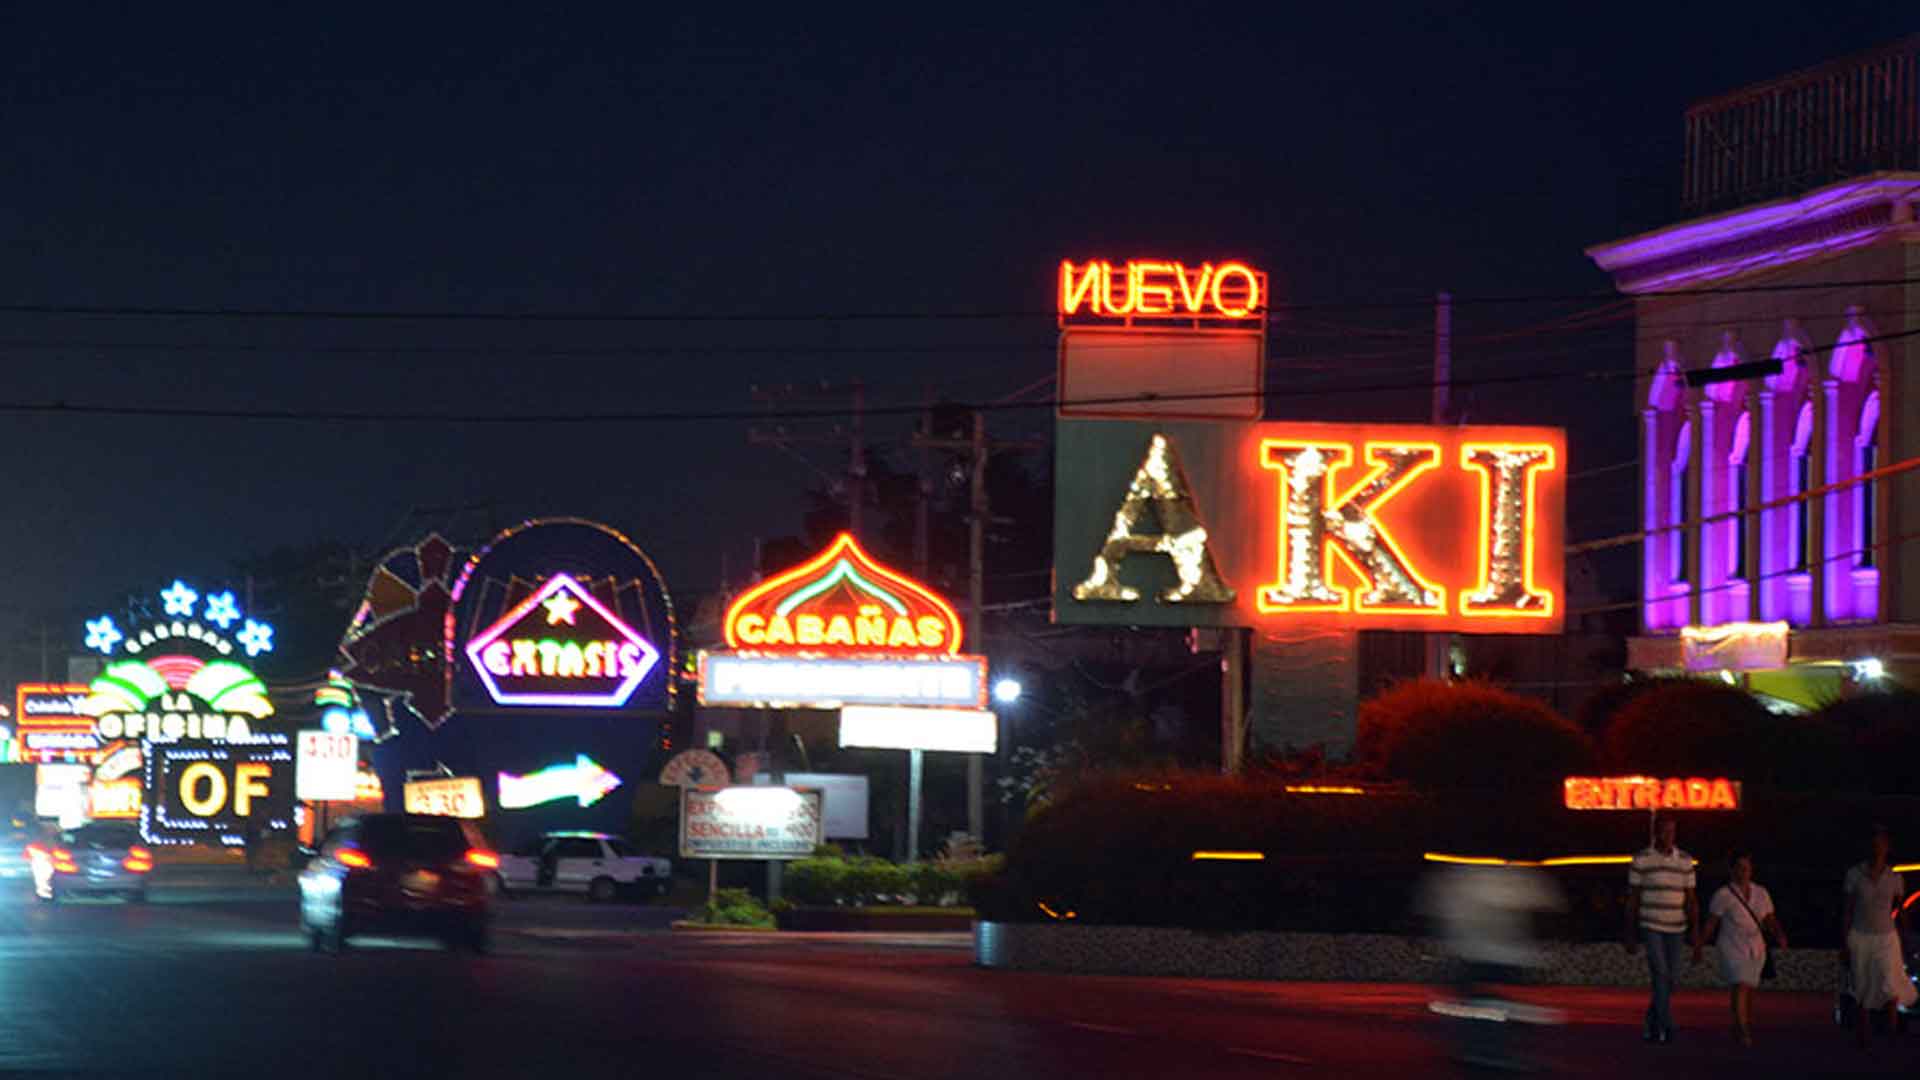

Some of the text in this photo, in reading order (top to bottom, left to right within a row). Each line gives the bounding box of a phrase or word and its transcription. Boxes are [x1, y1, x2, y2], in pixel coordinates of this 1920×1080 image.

[1061, 259, 1260, 318] NUEVO
[1072, 434, 1555, 617] AKI
[735, 605, 946, 647] CABAÑAS
[161, 692, 193, 712] LA
[179, 761, 272, 817] OF
[1564, 776, 1738, 810] ENTRADA
